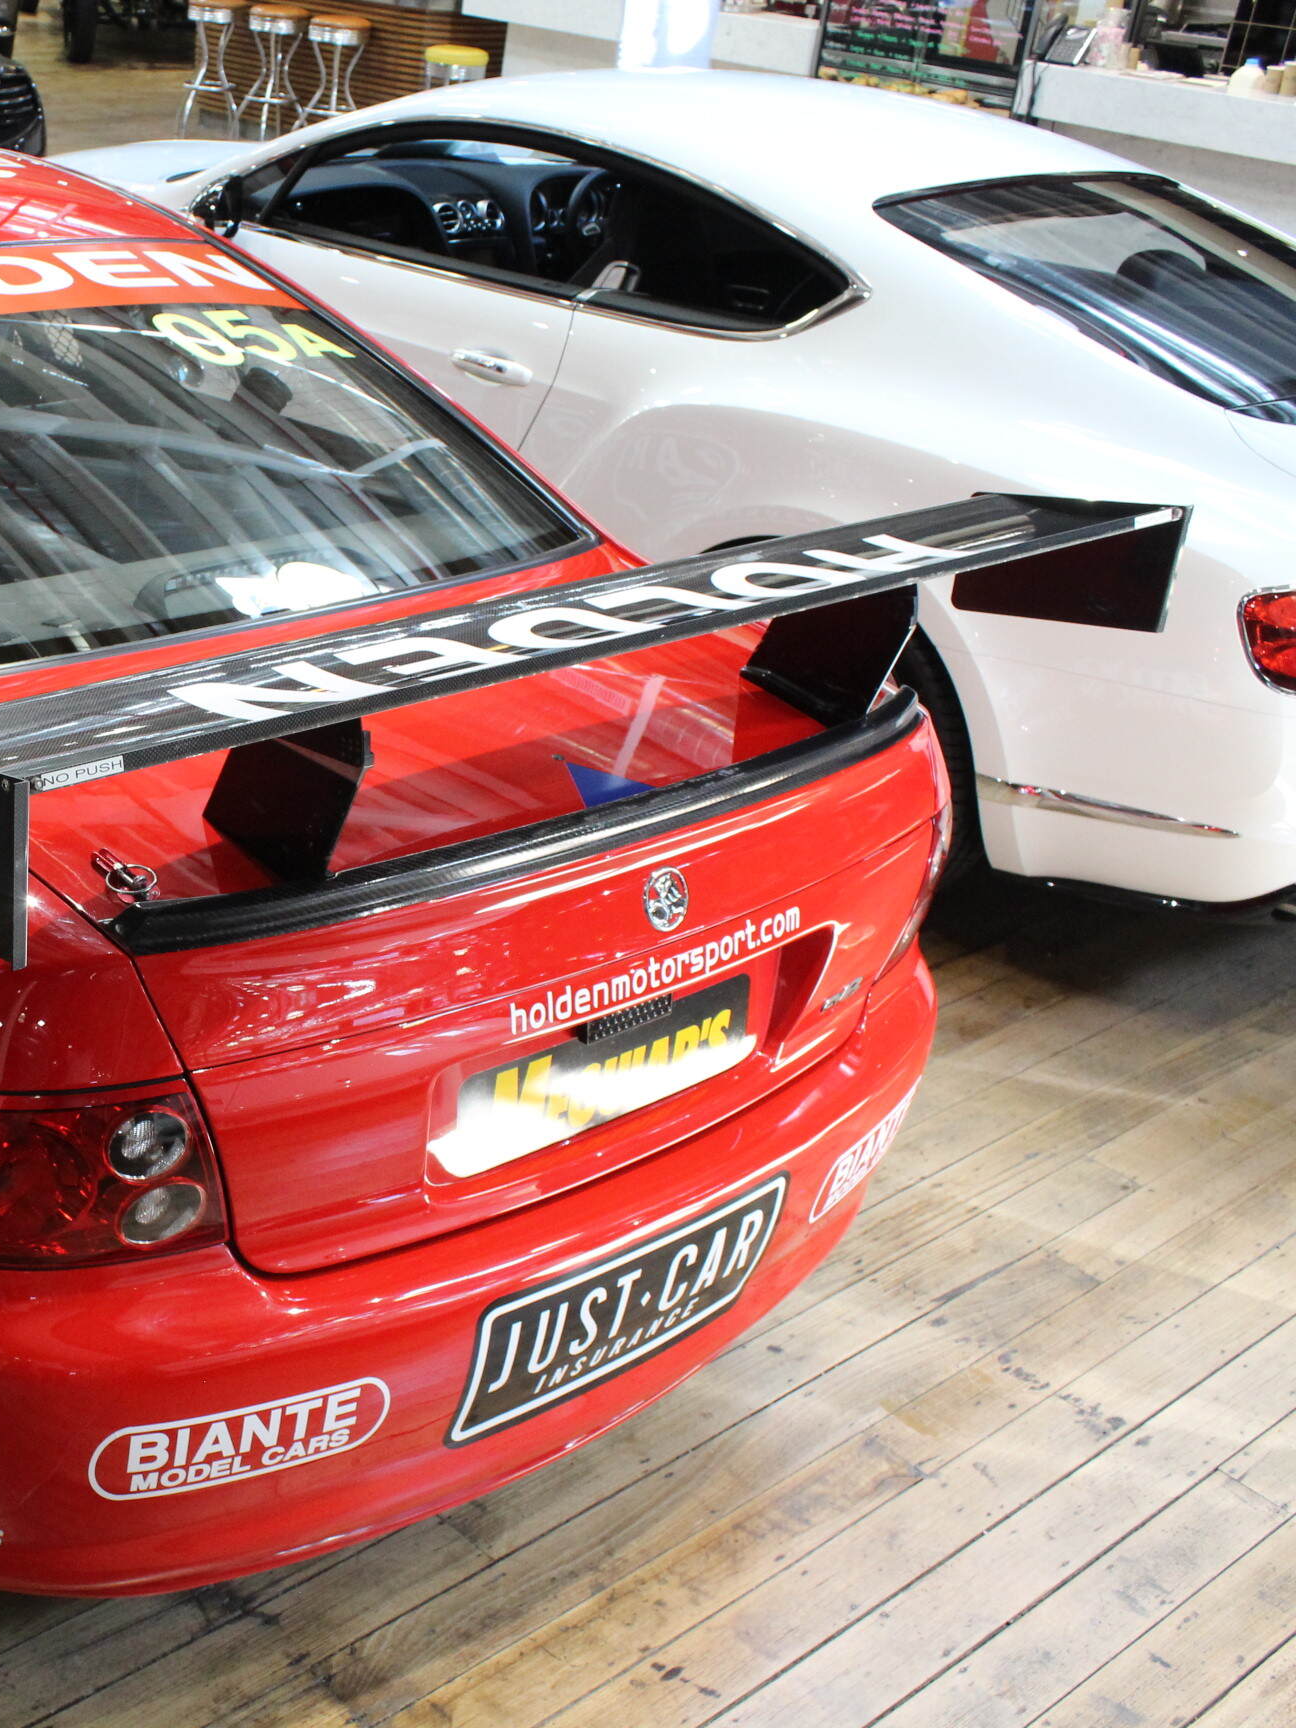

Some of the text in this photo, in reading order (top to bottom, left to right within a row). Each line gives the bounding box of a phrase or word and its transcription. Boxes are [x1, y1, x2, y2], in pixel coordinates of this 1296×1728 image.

[152, 308, 357, 367] 05A
[166, 534, 974, 723] HOLDEN
[43, 759, 123, 787] NO PUSH
[509, 905, 801, 1036] holdenmotorsport.com
[488, 1208, 765, 1395] JUST CAR
[534, 1296, 701, 1395] INSURANCE
[126, 1387, 362, 1474] BIANTE
[129, 1427, 351, 1492] MODEL CARS
